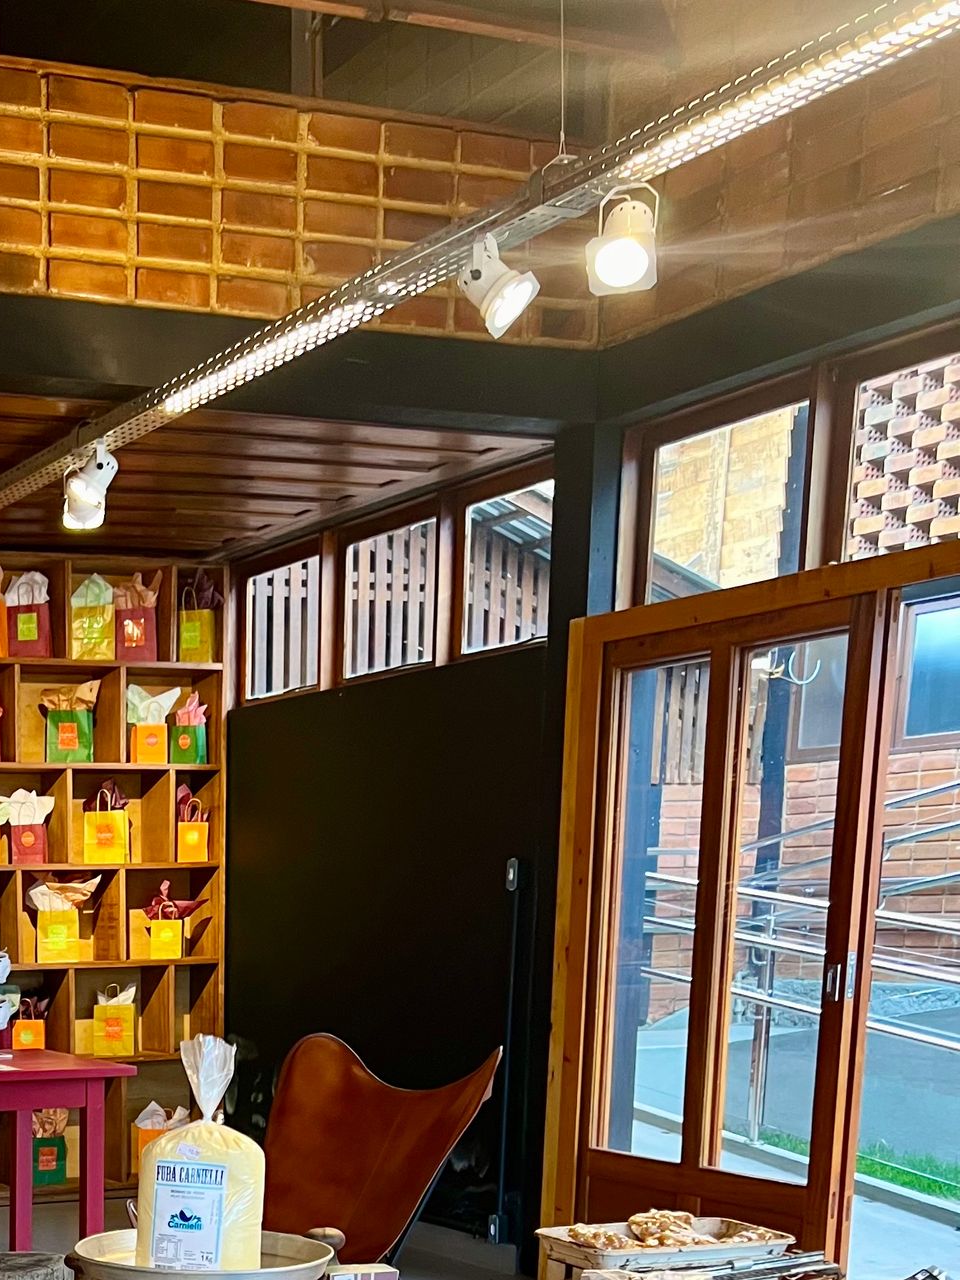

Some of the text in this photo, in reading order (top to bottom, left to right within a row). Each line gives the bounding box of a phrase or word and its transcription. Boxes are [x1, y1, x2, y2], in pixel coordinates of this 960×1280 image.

[156, 1163, 224, 1186] FUBÁ CARNIELLI
[167, 1220, 202, 1231] Carnielli
